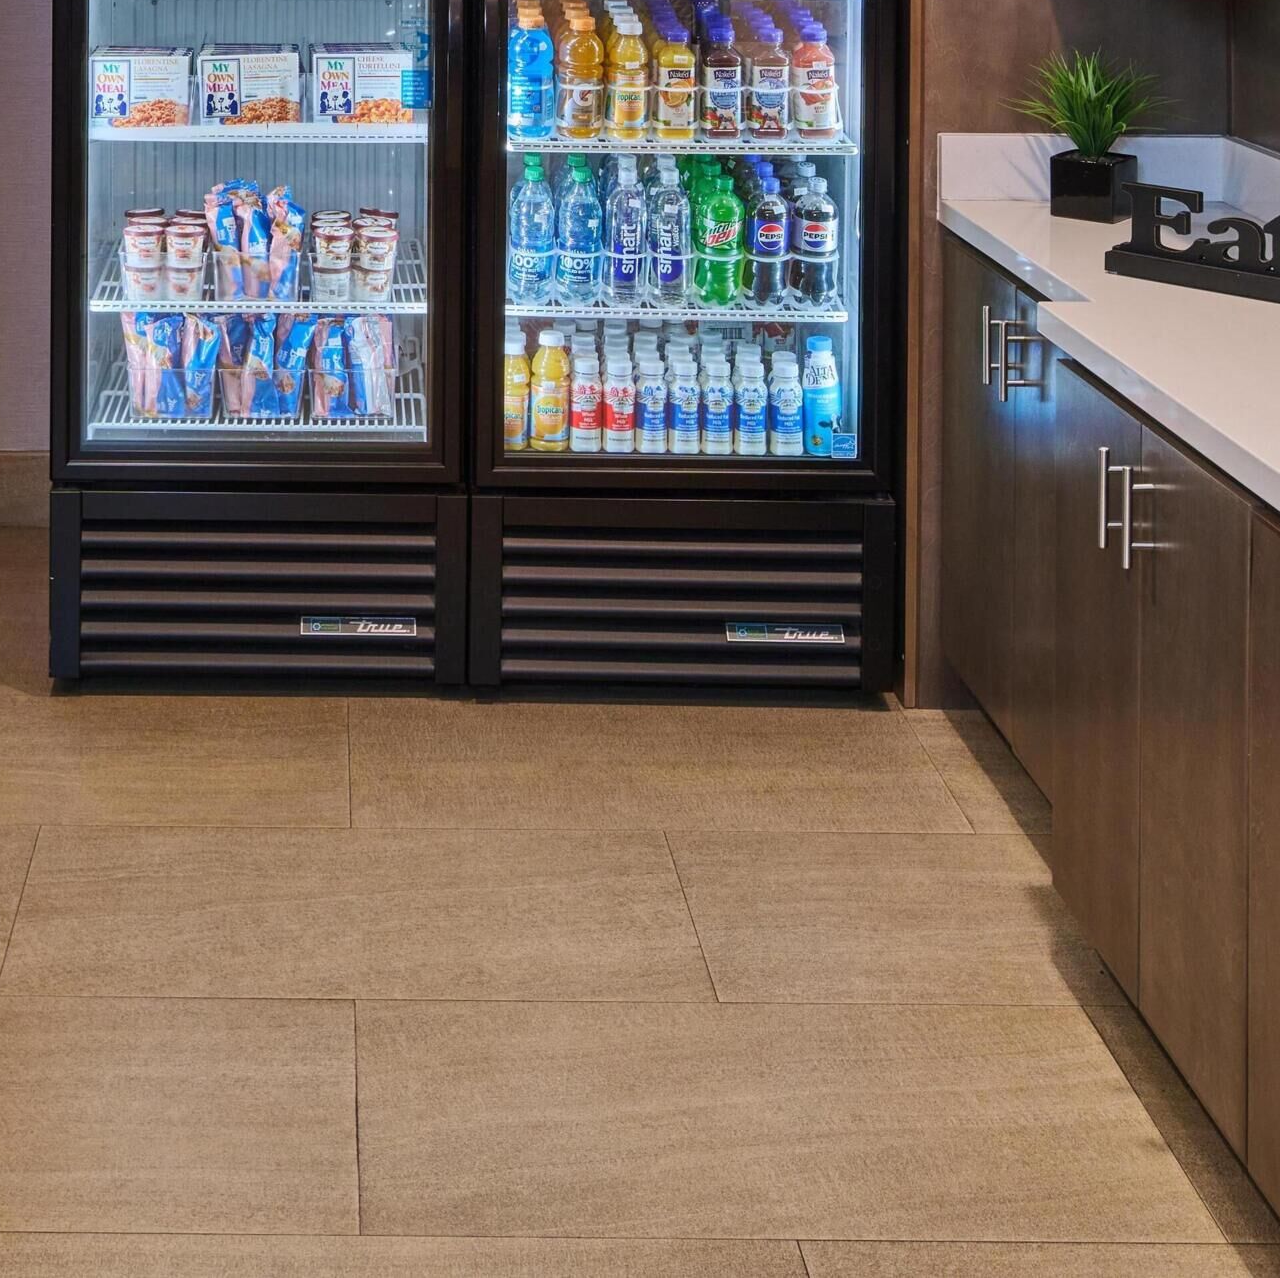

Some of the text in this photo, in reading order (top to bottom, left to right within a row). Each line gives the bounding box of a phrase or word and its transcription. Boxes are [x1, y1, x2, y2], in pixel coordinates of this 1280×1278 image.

[103, 64, 120, 73] MY
[212, 63, 230, 73] MY
[327, 61, 345, 70] MY
[97, 74, 125, 83] OWN
[207, 73, 235, 82] OWN
[322, 71, 350, 81] OWN
[669, 70, 689, 79] Naked
[715, 70, 736, 79] Naked
[808, 70, 830, 79] Naked
[96, 83, 127, 93] MEAL
[206, 83, 237, 93] MEAL
[320, 81, 351, 91] MEAL
[759, 232, 783, 240] PEPSI
